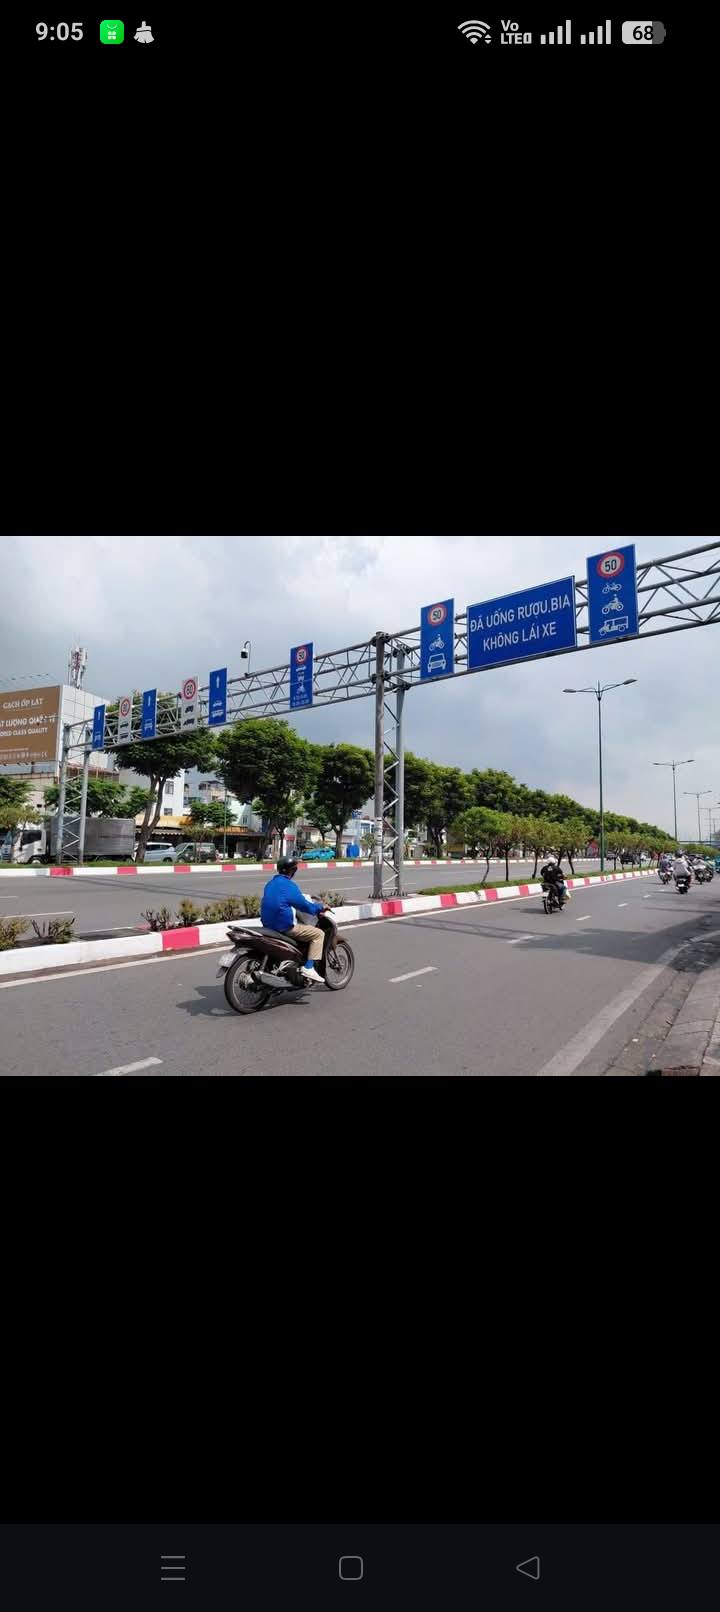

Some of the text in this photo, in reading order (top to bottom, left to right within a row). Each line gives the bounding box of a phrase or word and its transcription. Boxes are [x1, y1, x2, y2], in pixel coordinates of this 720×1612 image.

[604, 559, 617, 572] 50
[432, 609, 442, 621] 50
[470, 615, 484, 632] ĐÃ
[486, 607, 515, 628] UỐNG
[483, 621, 557, 652] KHÔNG LÁI XE
